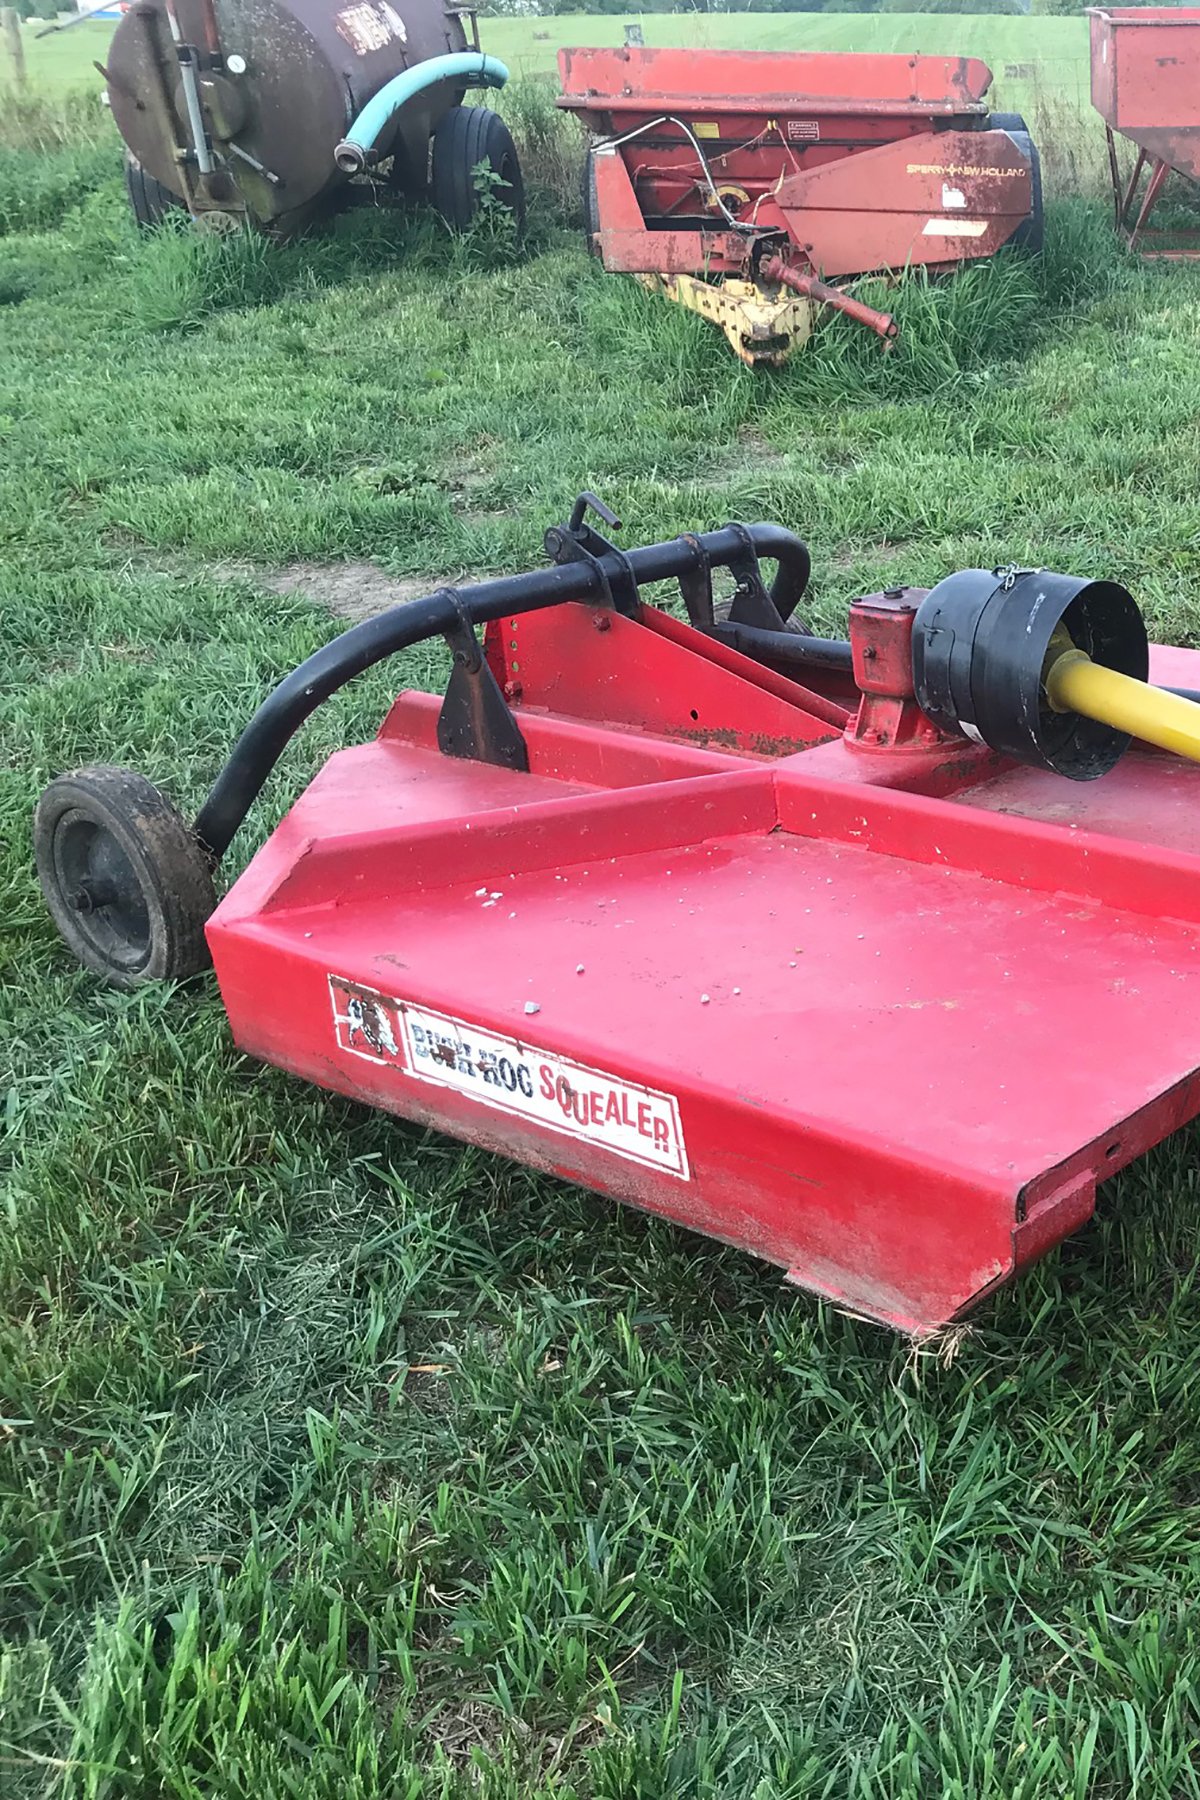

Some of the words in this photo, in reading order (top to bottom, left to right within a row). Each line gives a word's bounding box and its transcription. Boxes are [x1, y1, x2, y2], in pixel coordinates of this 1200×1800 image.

[906, 163, 947, 175] SPERRY
[957, 166, 980, 176] NEW
[980, 167, 1026, 177] HOLLAND
[539, 1064, 670, 1154] SQUEALER
